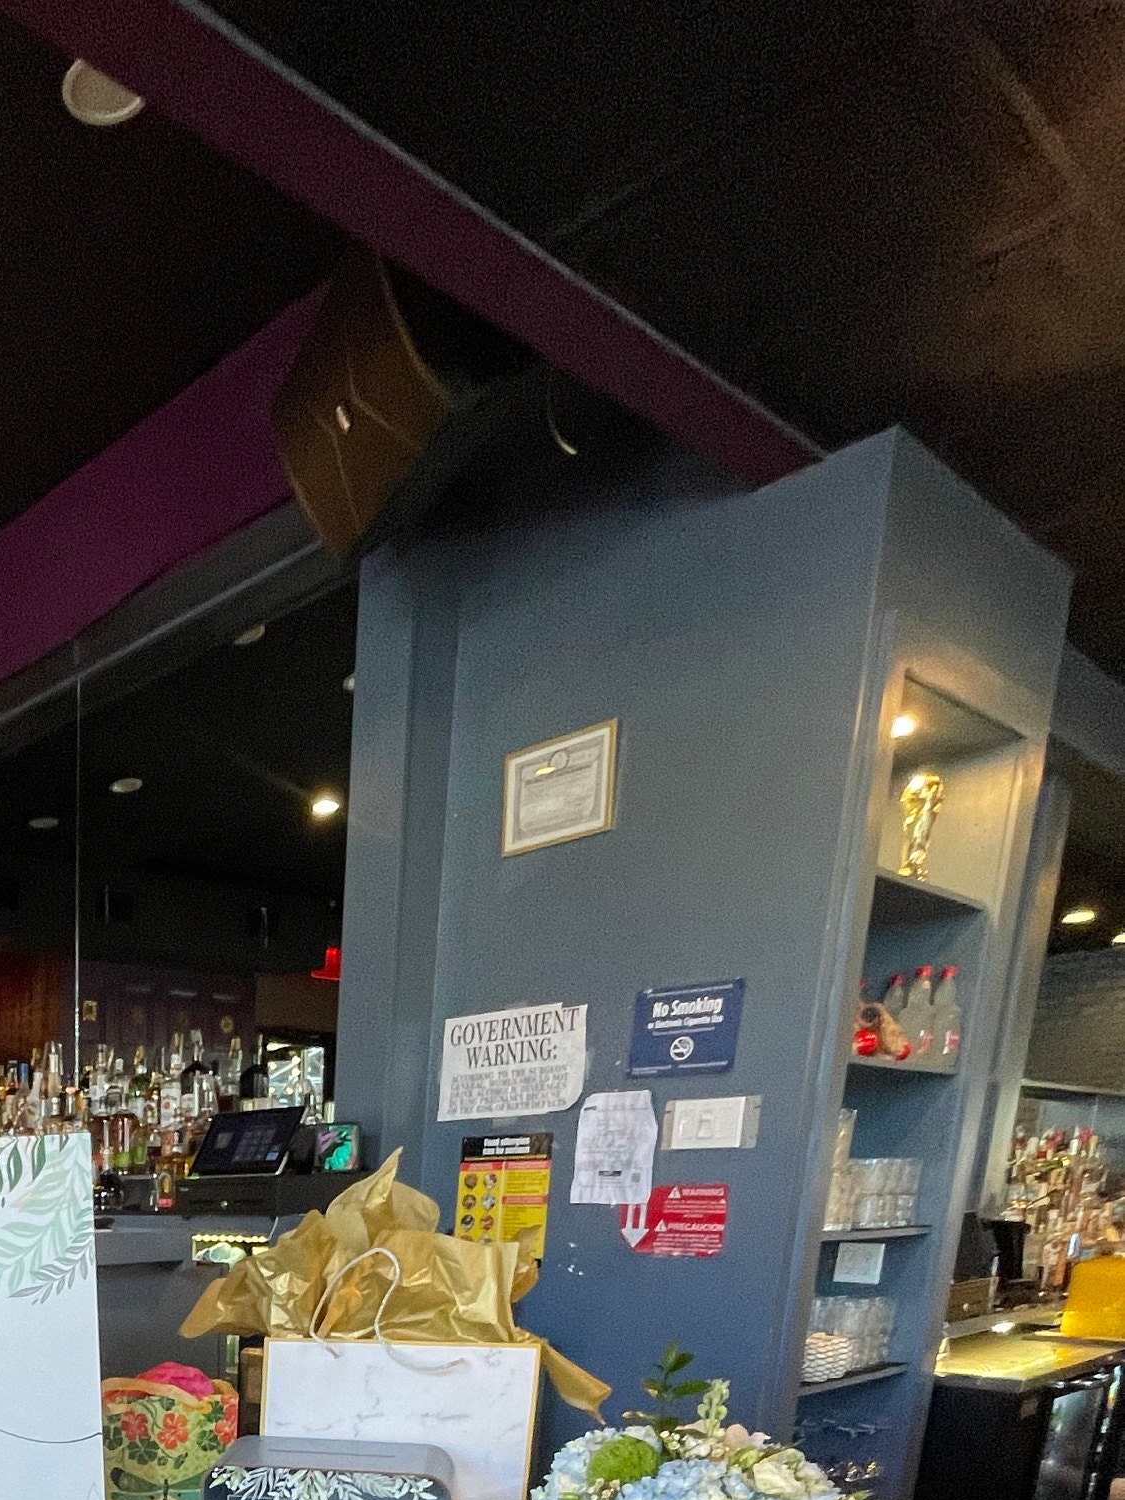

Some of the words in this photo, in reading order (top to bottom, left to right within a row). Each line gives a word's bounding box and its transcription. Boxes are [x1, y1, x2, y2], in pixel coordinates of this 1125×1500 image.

[652, 1001, 670, 1018] No
[670, 996, 724, 1016] Smoking
[450, 1007, 580, 1047] GOVERNMENT
[466, 1037, 557, 1069] WARNING:
[681, 1187, 725, 1196] WARNING
